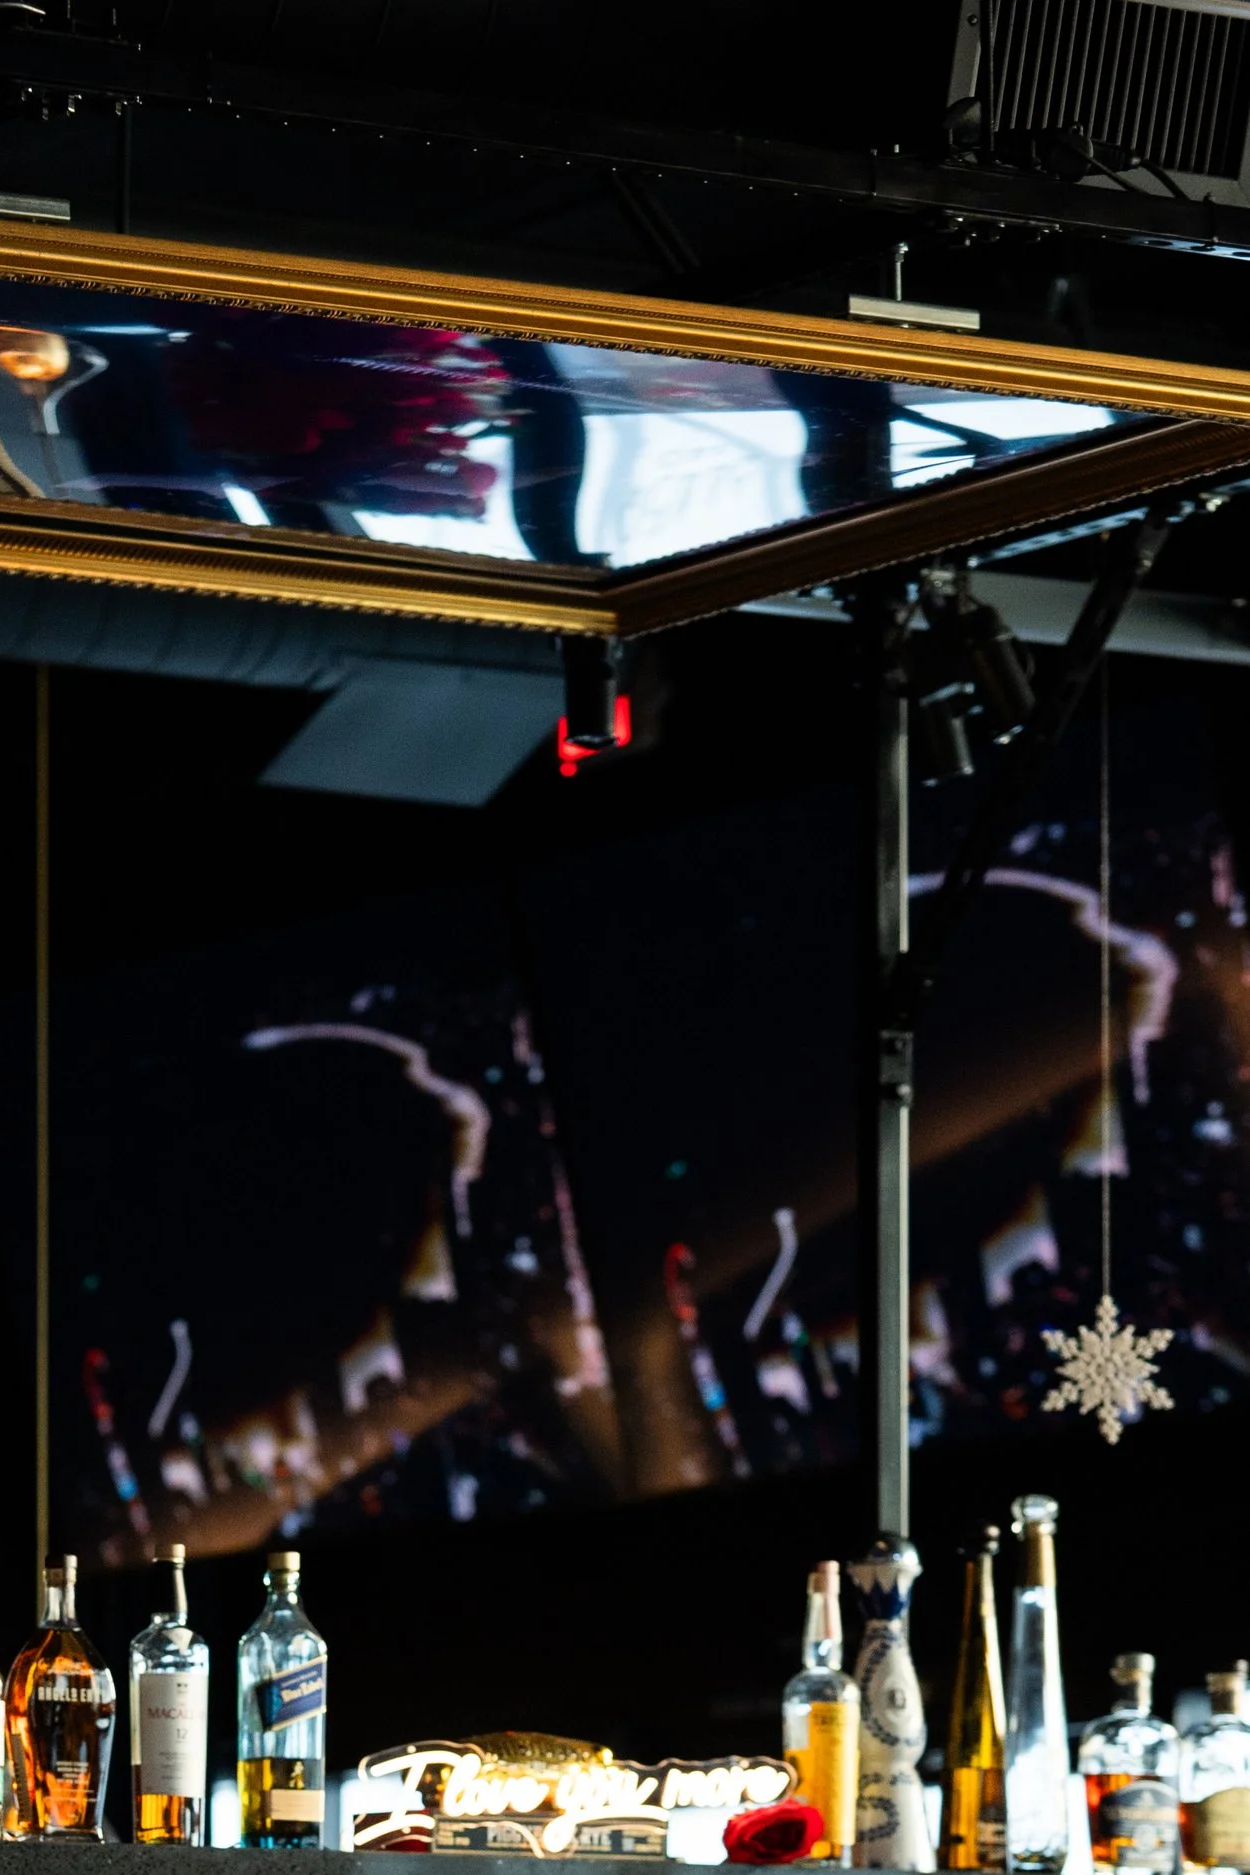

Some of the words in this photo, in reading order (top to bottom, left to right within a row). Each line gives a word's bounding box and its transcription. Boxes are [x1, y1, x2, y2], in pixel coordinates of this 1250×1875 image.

[147, 1707, 198, 1719] MACALL
[177, 1728, 188, 1739] 12
[444, 1754, 549, 1815] love
[543, 1765, 669, 1852] you
[660, 1766, 791, 1809] more
